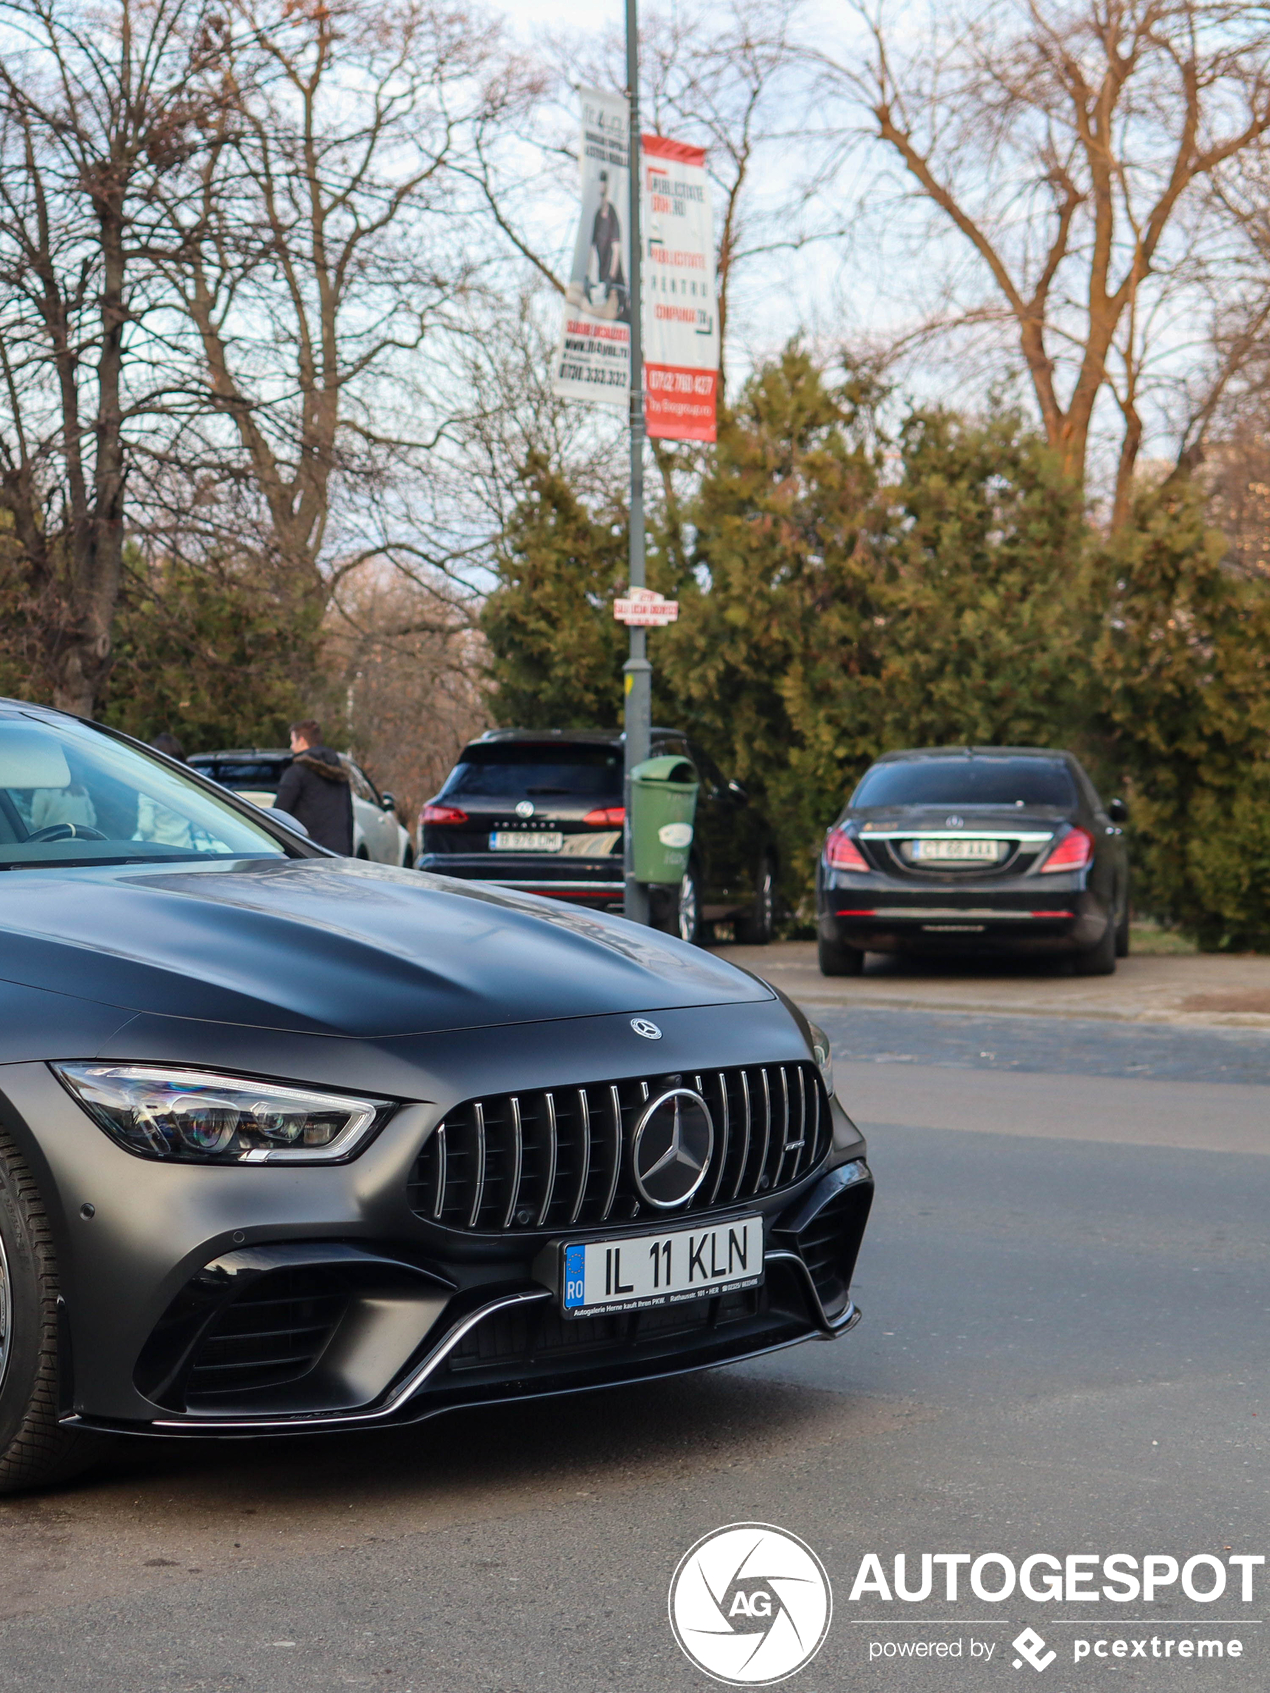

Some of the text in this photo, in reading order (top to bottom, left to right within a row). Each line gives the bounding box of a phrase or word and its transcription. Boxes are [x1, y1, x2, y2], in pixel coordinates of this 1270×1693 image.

[605, 1225, 748, 1296] IL 11 KLN
[567, 1279, 583, 1300] RO
[573, 1306, 606, 1317] Autogalerie
[606, 1303, 623, 1312] Herne
[623, 1301, 637, 1310] kauft
